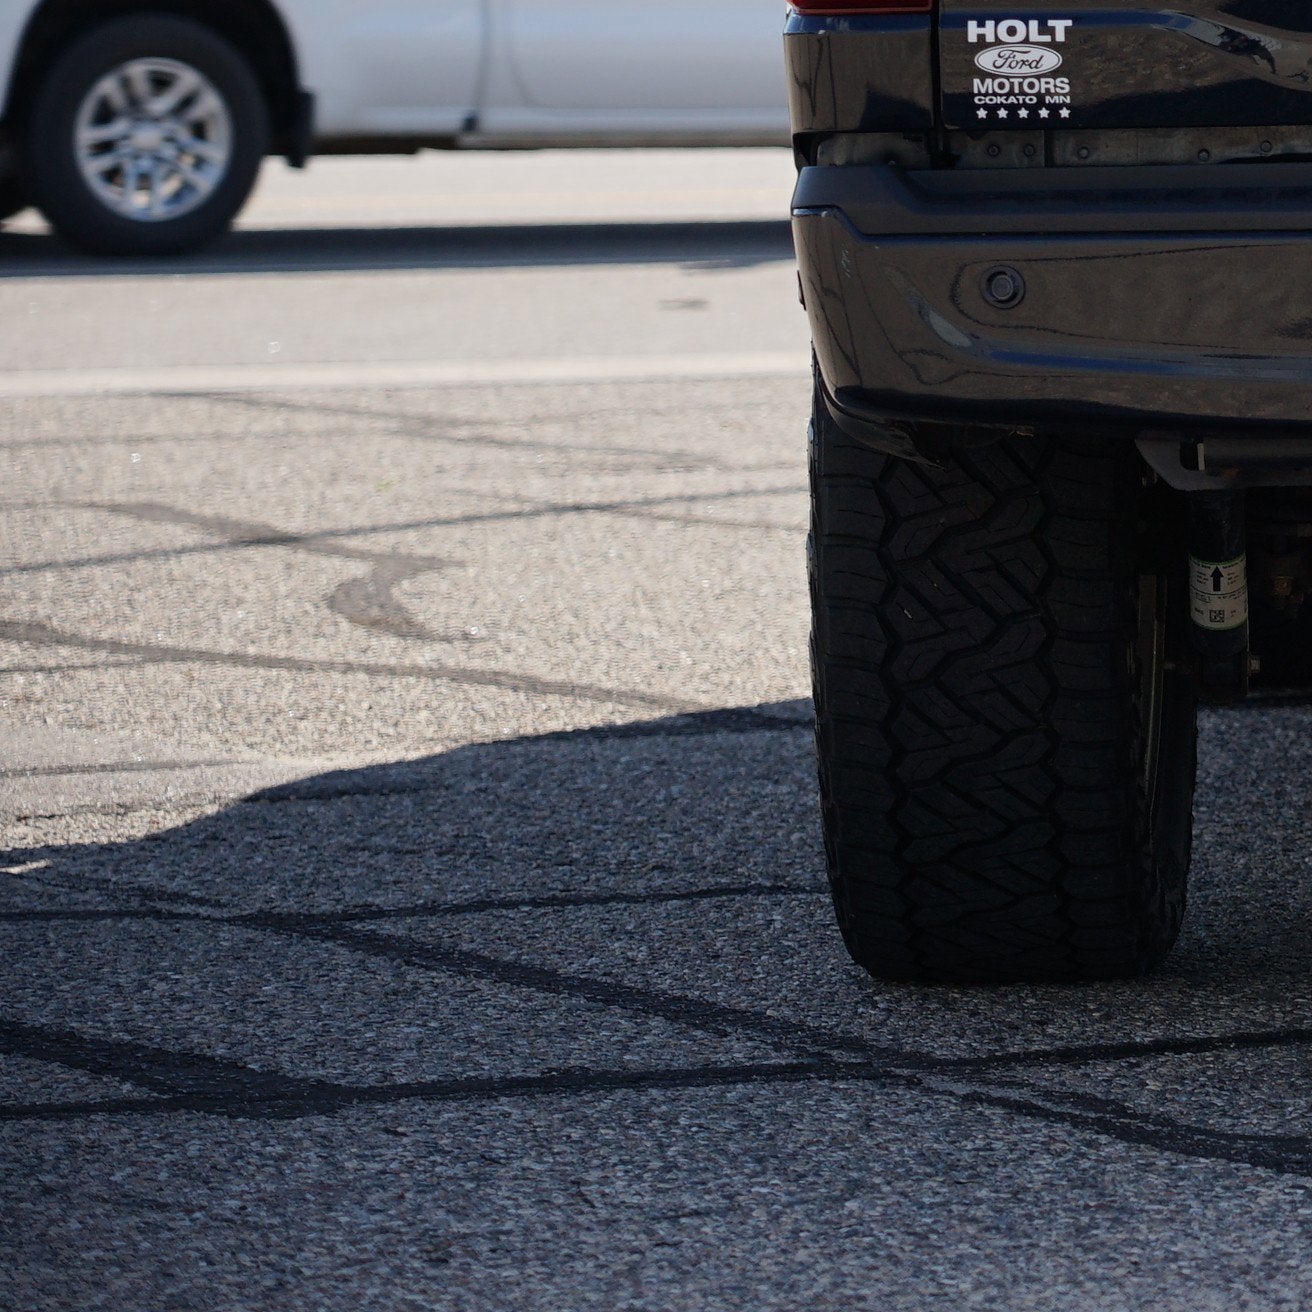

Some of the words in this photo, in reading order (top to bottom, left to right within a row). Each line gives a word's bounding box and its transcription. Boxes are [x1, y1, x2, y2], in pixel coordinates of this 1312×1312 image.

[967, 19, 1073, 43] HOLT
[992, 50, 1044, 71] Ford
[973, 78, 1071, 94] MOTORS
[974, 95, 1037, 104] COKATO
[1045, 95, 1071, 104] MN
